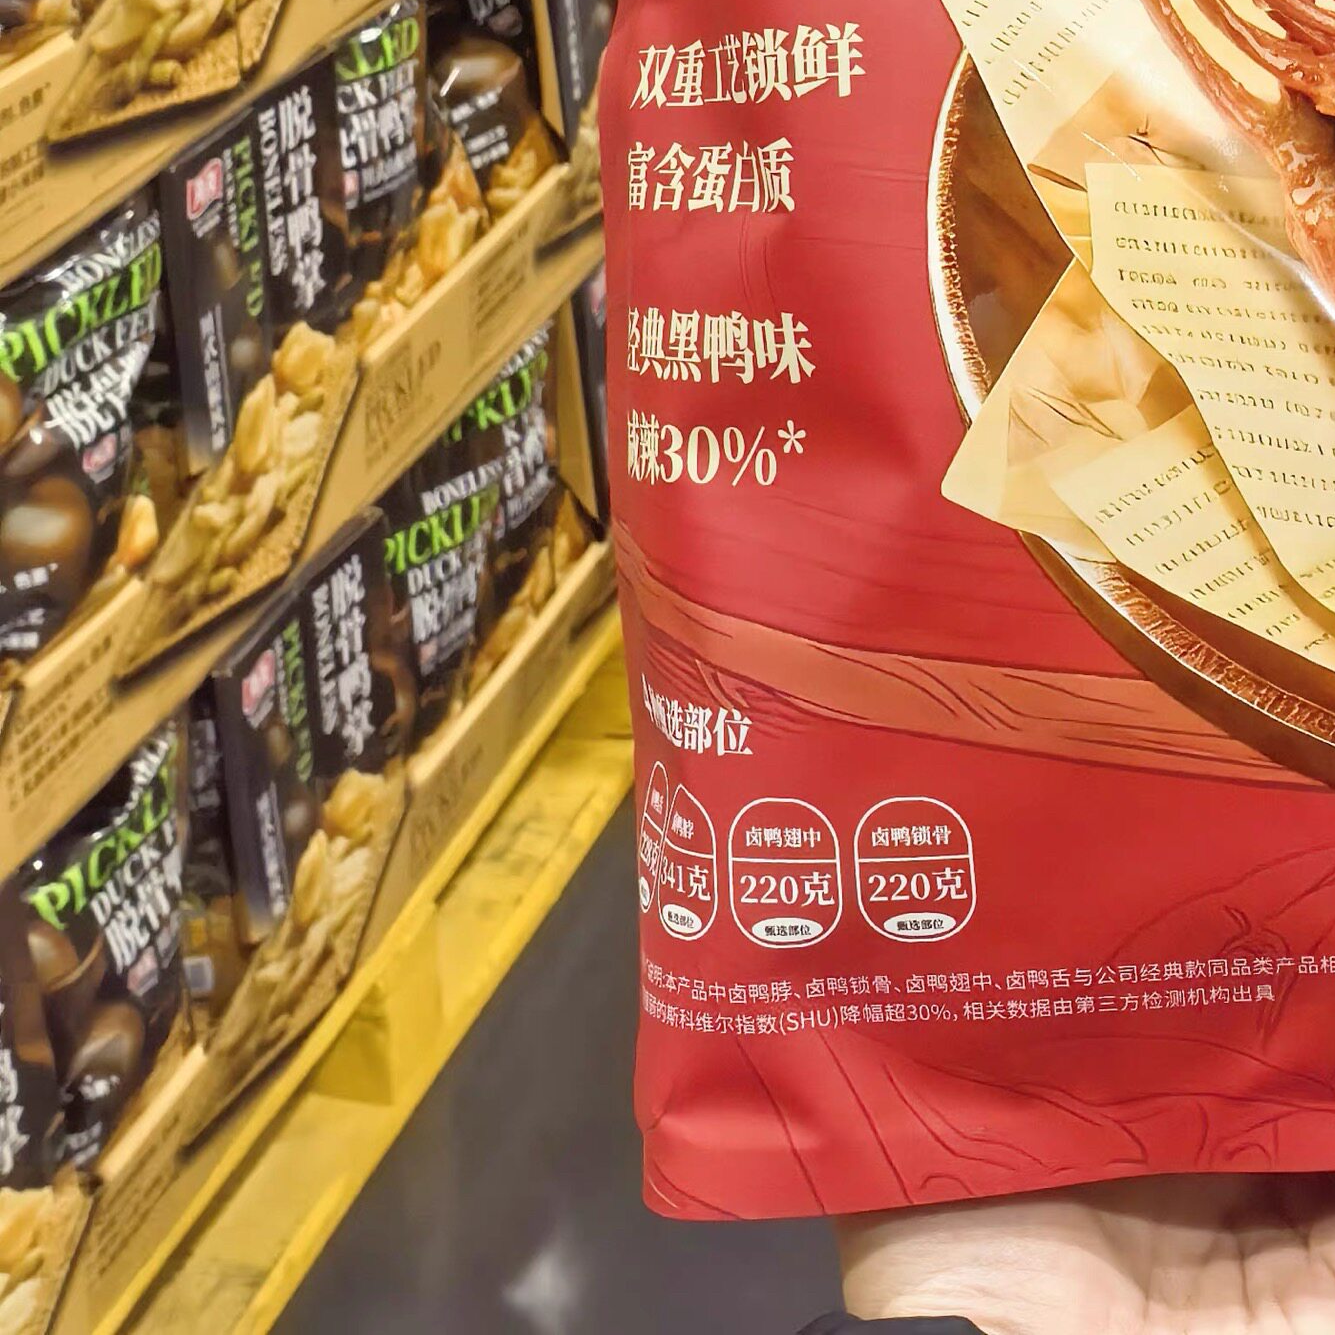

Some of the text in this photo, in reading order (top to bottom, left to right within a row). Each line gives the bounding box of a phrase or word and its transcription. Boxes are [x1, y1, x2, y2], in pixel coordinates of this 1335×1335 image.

[628, 21, 867, 110] 双重工艺锁鲜
[627, 136, 796, 214] 富含蛋白质
[627, 305, 816, 385] 经典黑鸭味
[744, 826, 822, 849] 卤鸭翅中
[871, 825, 952, 848] 卤鸭锁骨
[660, 855, 712, 902] 341克
[739, 871, 836, 908] 220克
[867, 867, 968, 903] 220克
[764, 925, 812, 937] 甄选部位
[896, 918, 945, 932] 甄选部位
